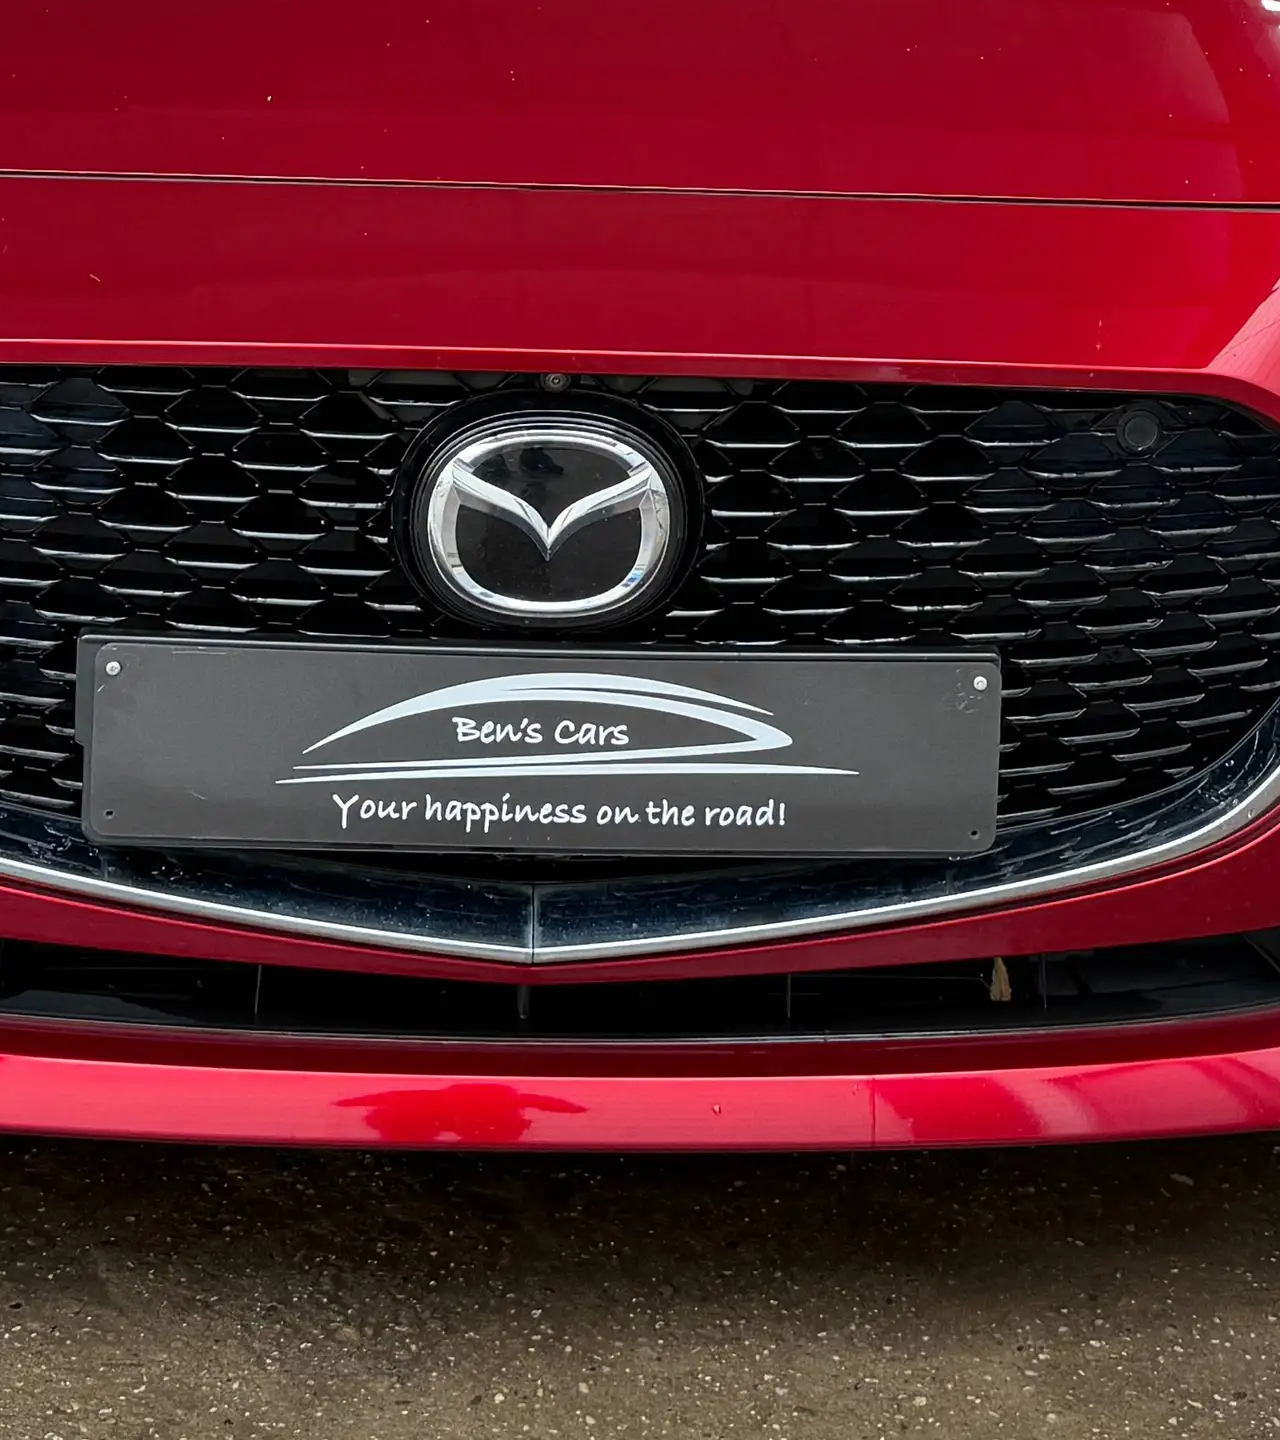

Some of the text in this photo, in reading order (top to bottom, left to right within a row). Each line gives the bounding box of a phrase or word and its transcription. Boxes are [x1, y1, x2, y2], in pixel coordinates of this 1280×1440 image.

[452, 716, 630, 746] Ben's Cars
[332, 792, 786, 833] Your happiness on the road!
